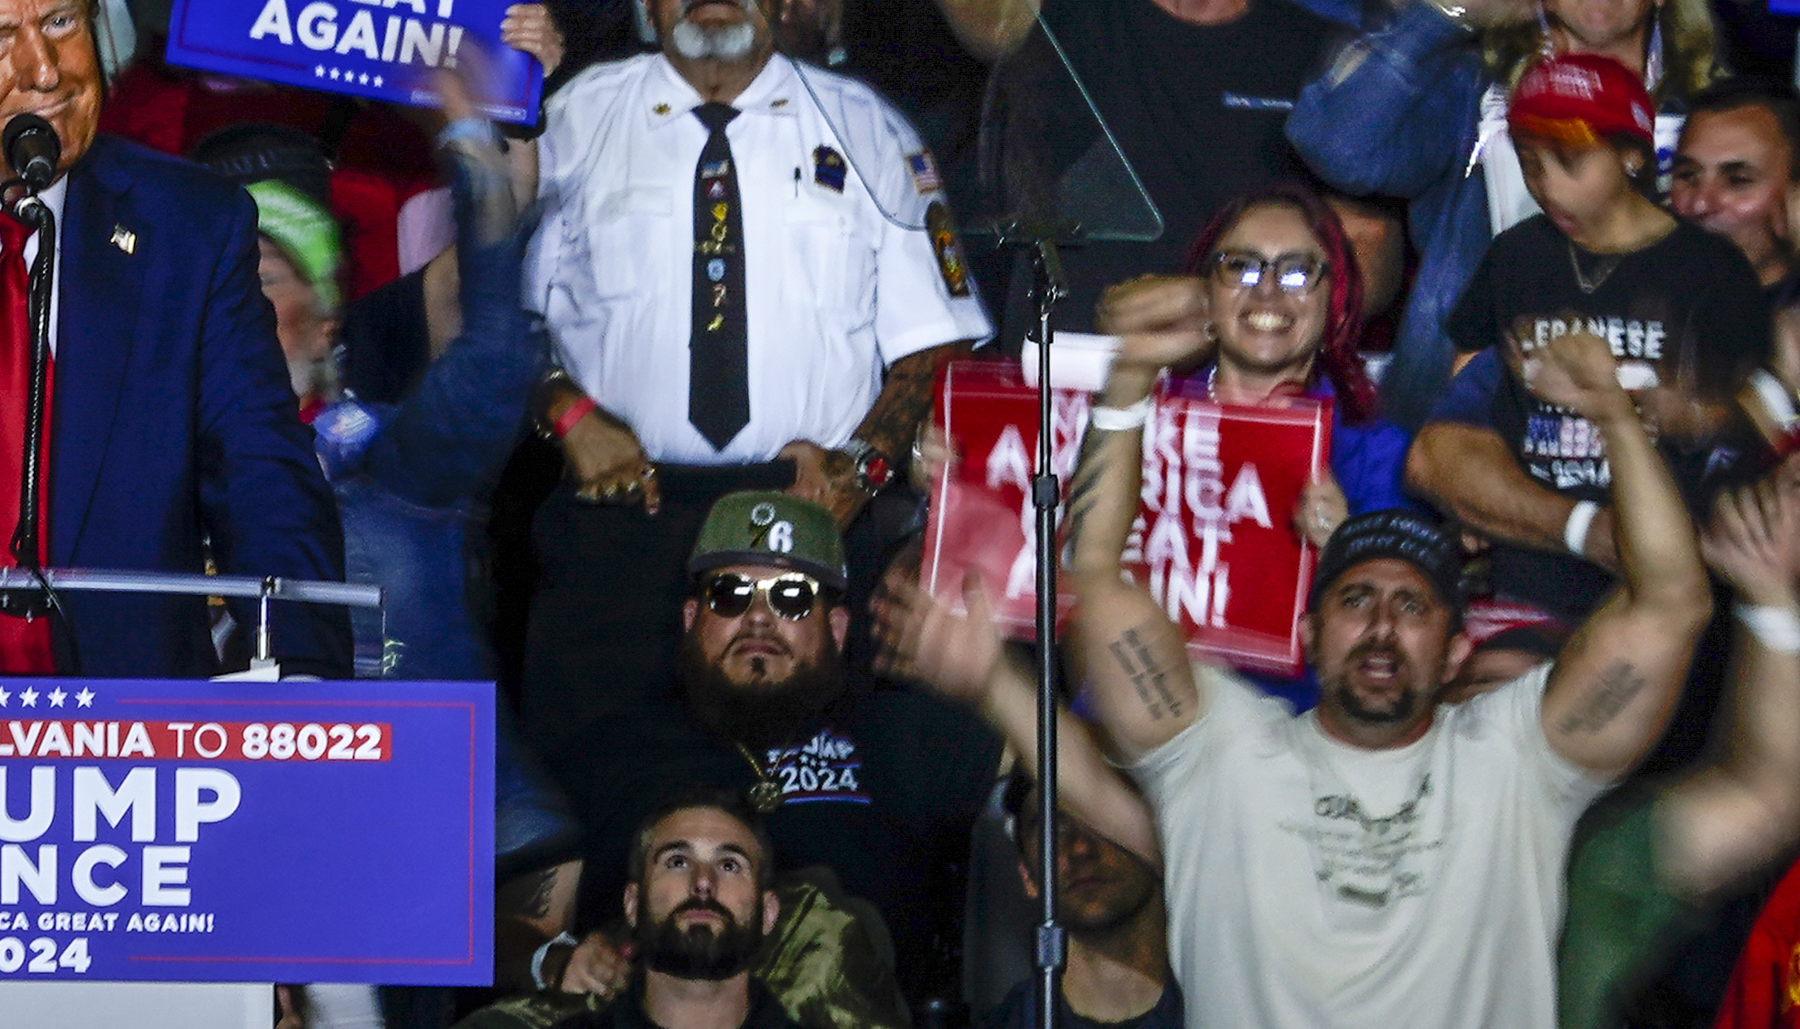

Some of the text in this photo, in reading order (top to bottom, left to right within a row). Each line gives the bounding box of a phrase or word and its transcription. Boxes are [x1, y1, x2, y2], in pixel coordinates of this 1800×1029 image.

[167, 722, 227, 759] TO
[241, 722, 382, 761] 88022
[779, 766, 858, 794] 2024
[38, 911, 118, 932] GREAT
[126, 912, 215, 933] AGAIN!
